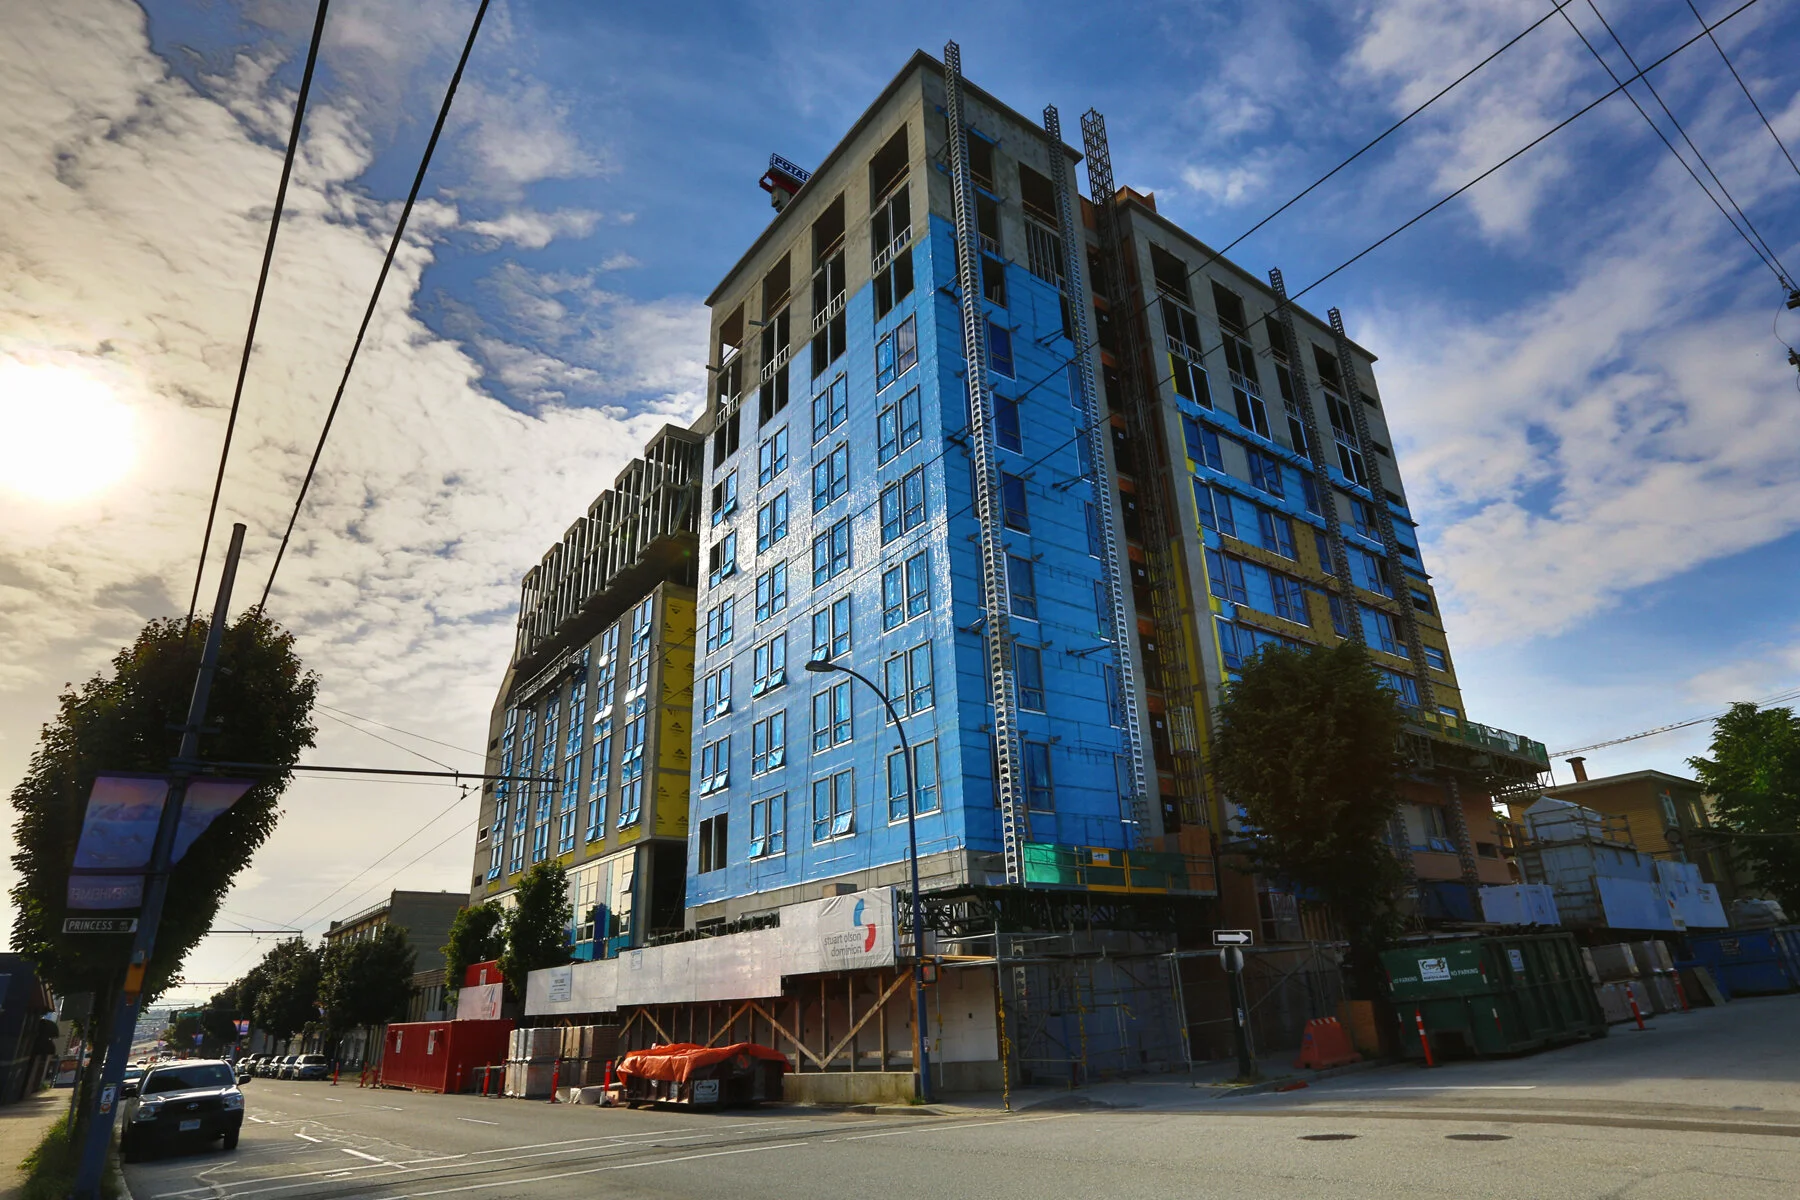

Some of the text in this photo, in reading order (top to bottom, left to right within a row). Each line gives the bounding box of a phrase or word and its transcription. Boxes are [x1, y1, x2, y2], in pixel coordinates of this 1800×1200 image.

[775, 156, 811, 181] POTAI
[68, 921, 113, 930] PRINCESS
[824, 932, 861, 946] stuart olson
[831, 944, 861, 957] dominion
[1457, 968, 1479, 976] PARKING
